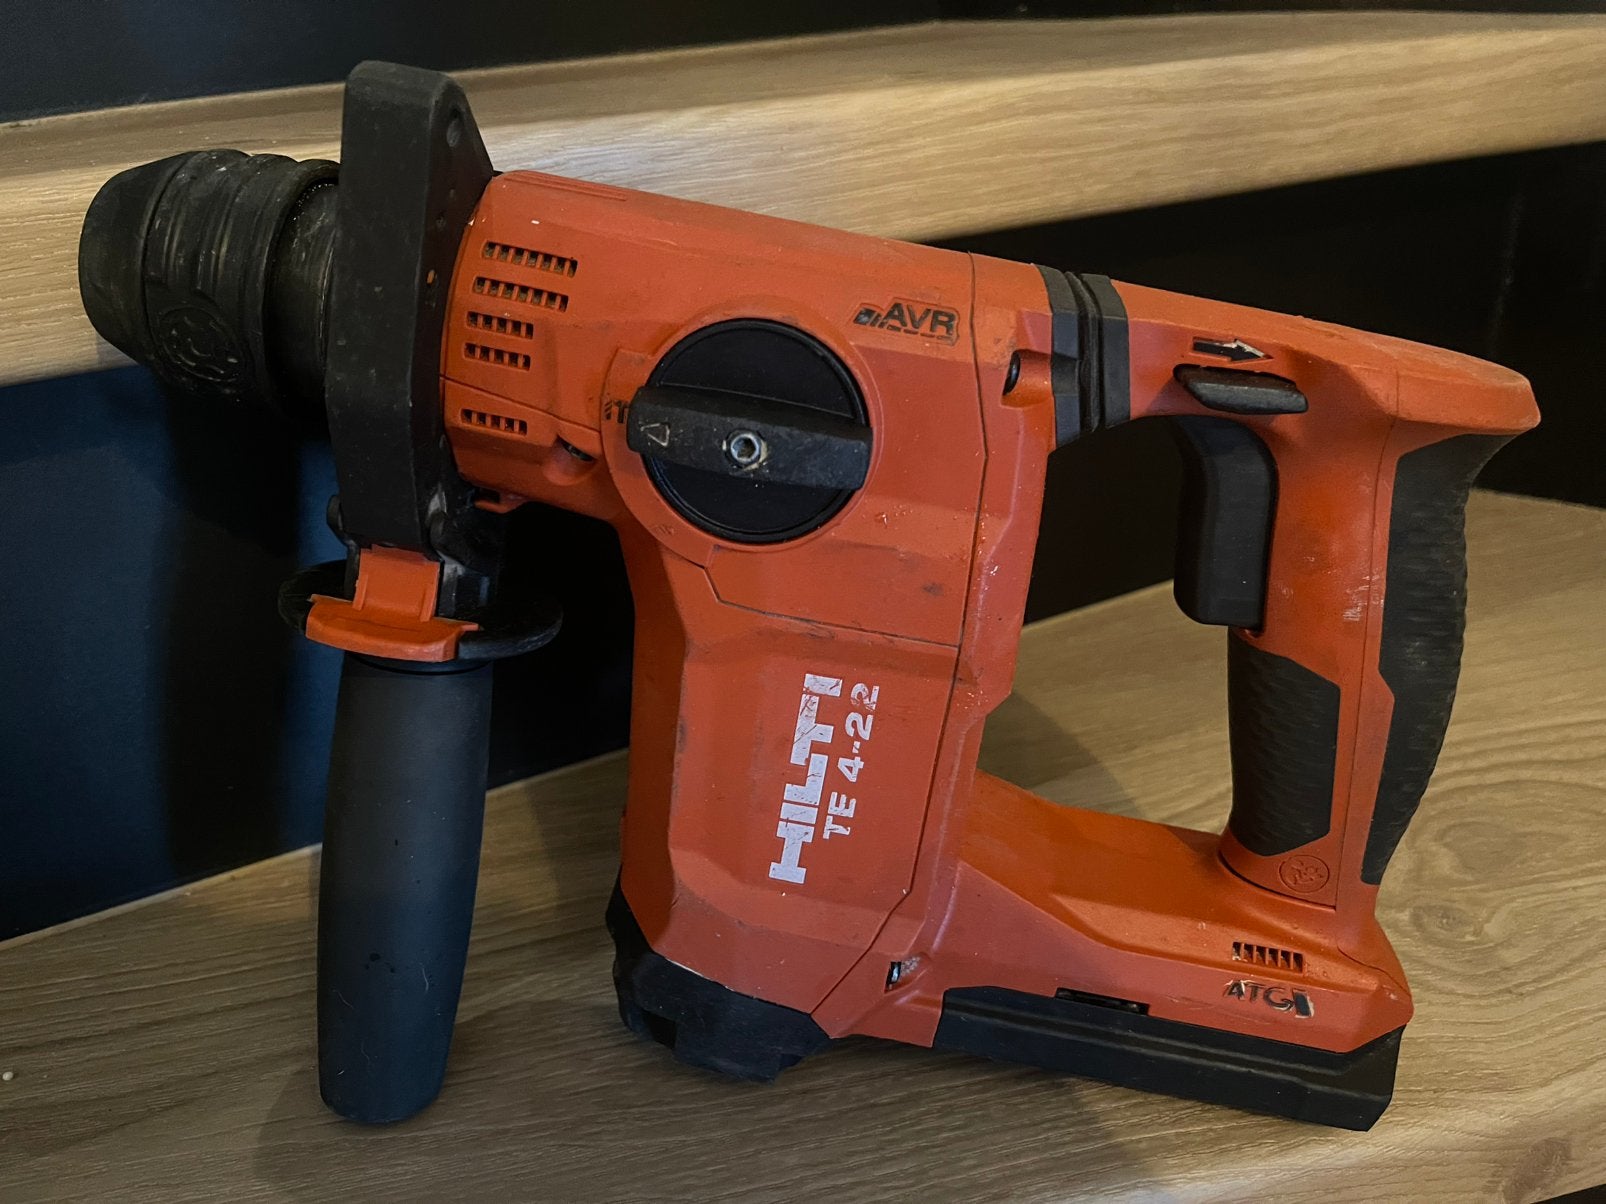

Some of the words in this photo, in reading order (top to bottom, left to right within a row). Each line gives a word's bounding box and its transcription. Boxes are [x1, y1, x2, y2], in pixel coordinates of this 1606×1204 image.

[882, 302, 957, 336] AVR
[837, 682, 880, 783] 4-22
[768, 673, 843, 884] HILTI
[822, 791, 857, 839] TE
